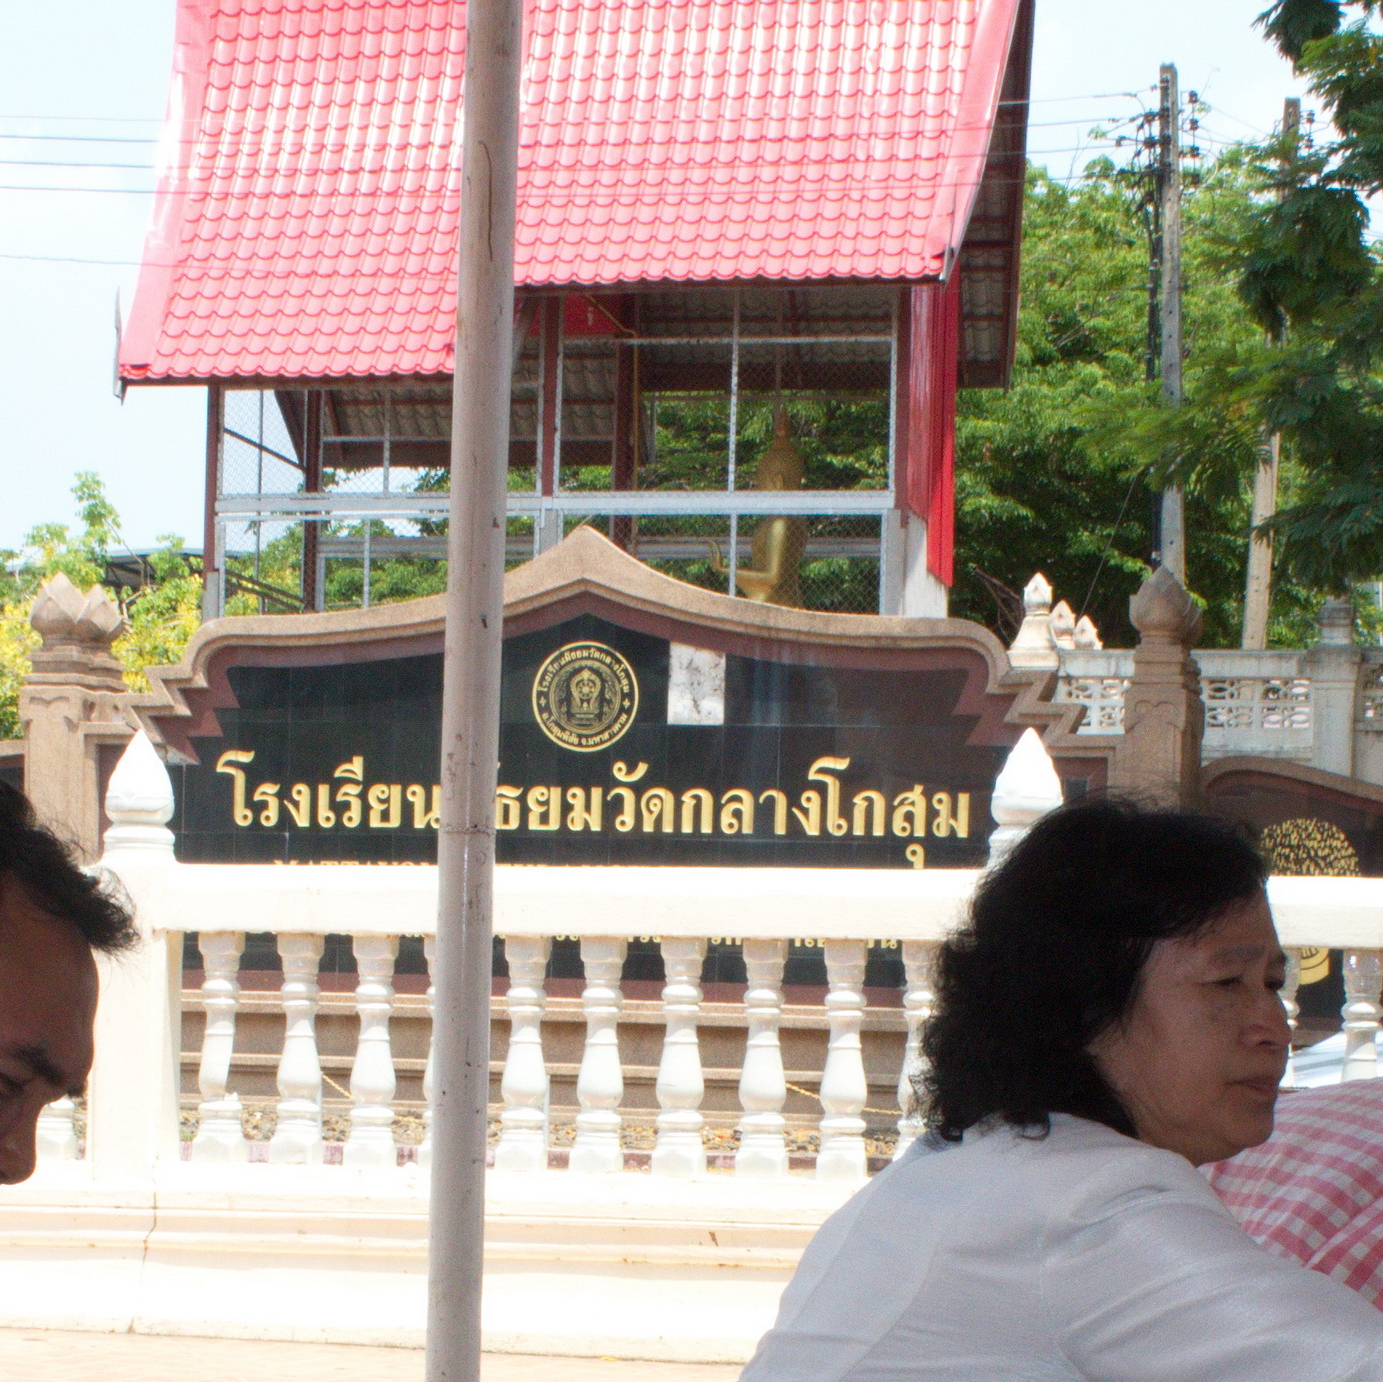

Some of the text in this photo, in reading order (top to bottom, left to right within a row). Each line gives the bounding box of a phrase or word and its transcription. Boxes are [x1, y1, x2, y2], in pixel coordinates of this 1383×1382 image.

[216, 749, 970, 869] โรงเรียนธยมวัดกลางโกสุม
